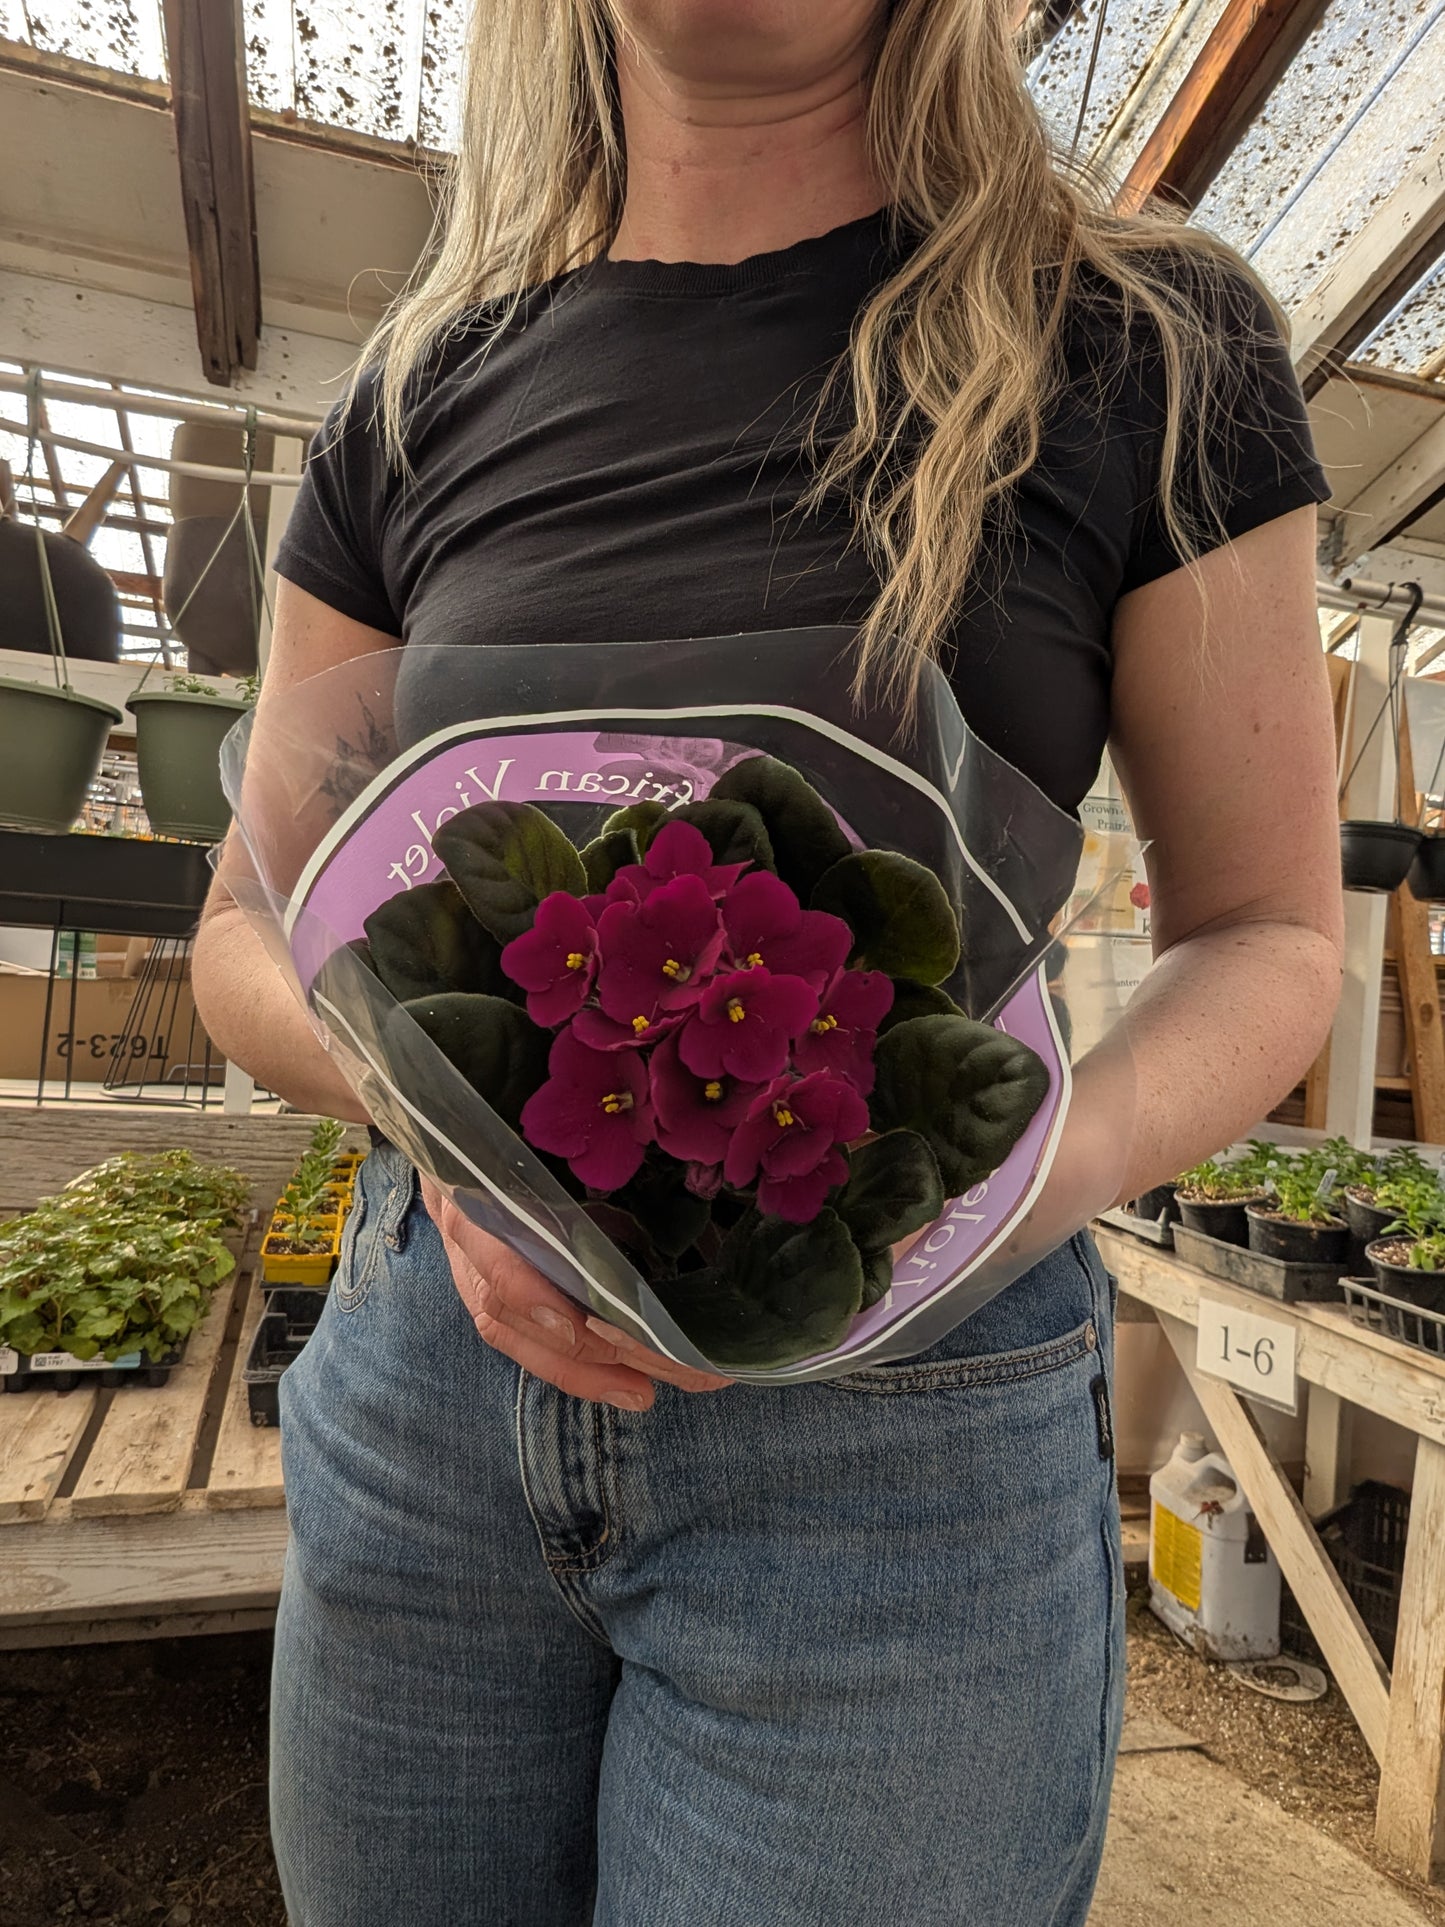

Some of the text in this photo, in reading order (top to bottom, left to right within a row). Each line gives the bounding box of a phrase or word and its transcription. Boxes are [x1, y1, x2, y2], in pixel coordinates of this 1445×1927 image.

[1082, 802, 1119, 816] Grown
[56, 1033, 169, 1059] T623-2
[1220, 1325, 1275, 1376] 1-6
